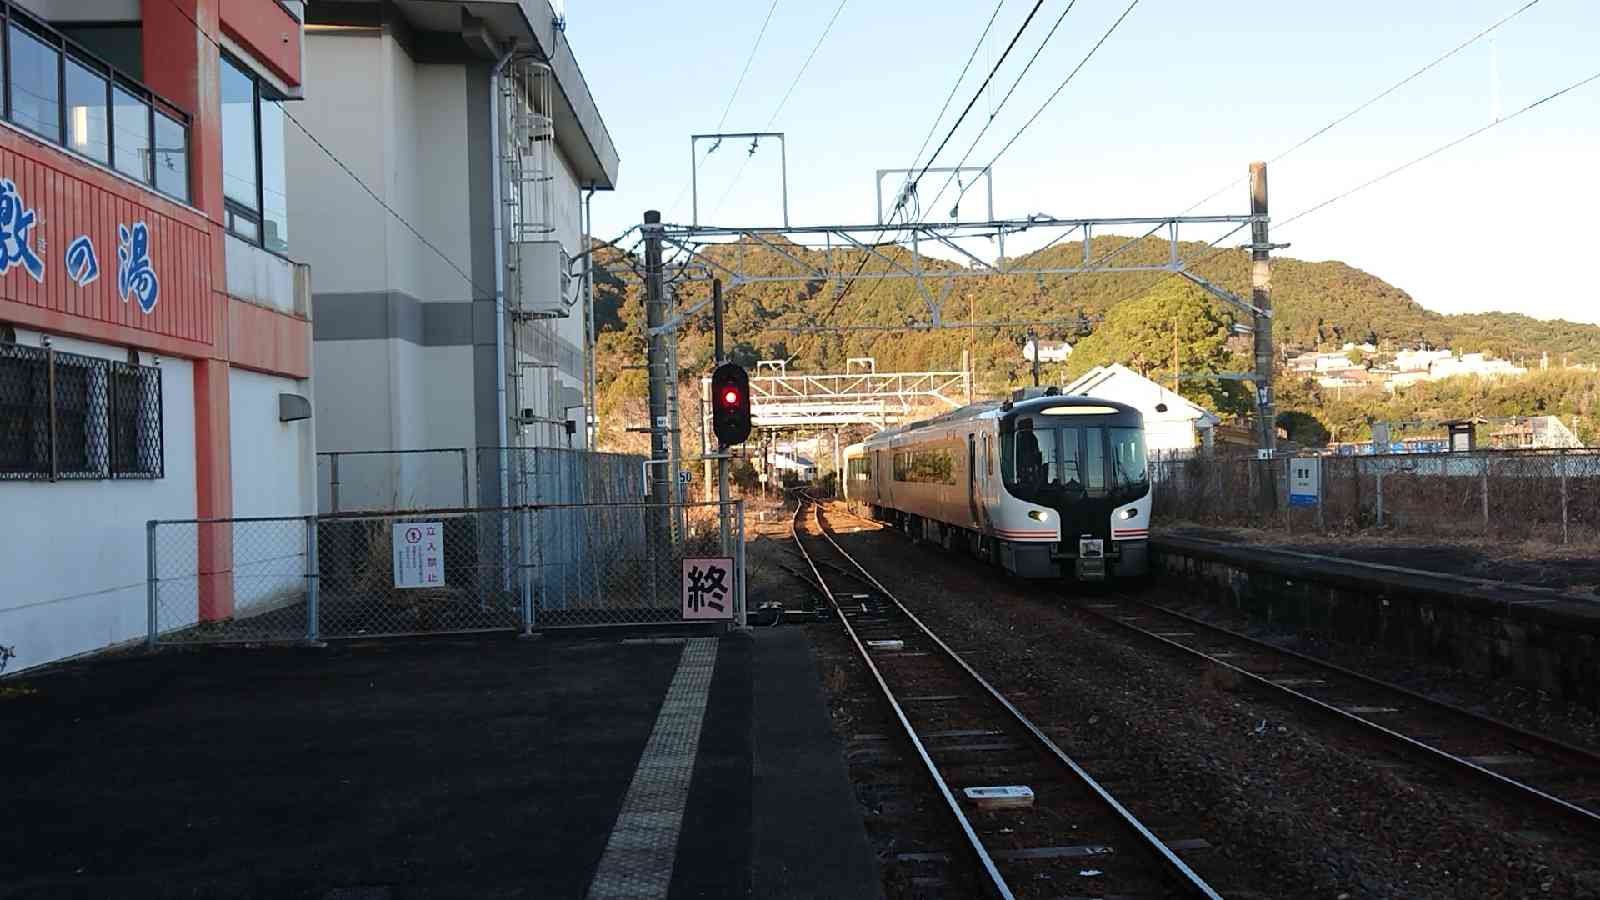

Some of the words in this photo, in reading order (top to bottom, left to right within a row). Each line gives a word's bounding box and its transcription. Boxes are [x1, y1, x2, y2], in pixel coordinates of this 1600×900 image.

[425, 527, 438, 582] 立入禁止
[688, 565, 728, 612] 終
